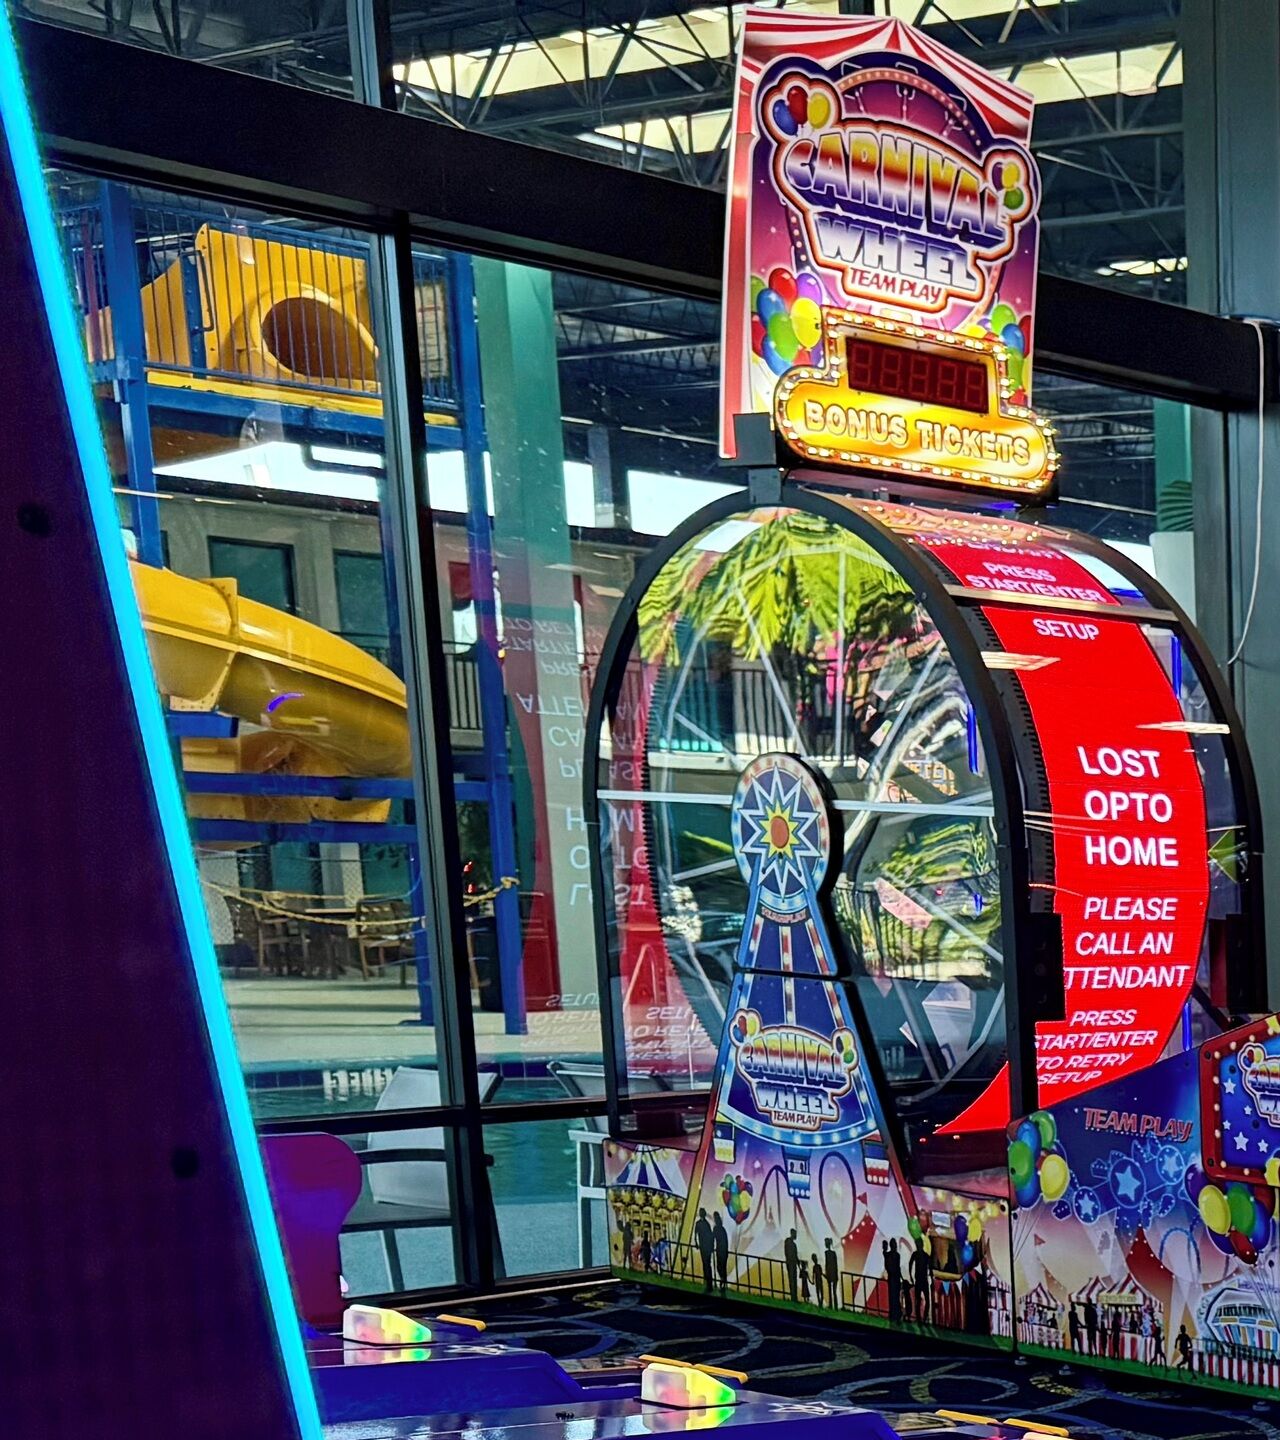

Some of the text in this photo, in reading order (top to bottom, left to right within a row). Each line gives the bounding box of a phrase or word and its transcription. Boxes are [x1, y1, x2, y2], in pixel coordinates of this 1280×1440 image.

[785, 131, 1007, 242] CARNIVAL
[814, 217, 978, 291] WHEEL
[848, 267, 943, 304] TEAM PLAY
[804, 399, 1031, 467] BONUS TICKETS
[982, 562, 1056, 582] PRESS
[965, 575, 1107, 603] START/ENTER
[1032, 618, 1099, 640] SETUP
[1078, 746, 1160, 778] LOST
[1084, 790, 1173, 823] OPTO
[1086, 836, 1179, 867] HOME
[1084, 897, 1178, 921] PLEASE
[1076, 932, 1173, 955] CALL AN
[1063, 965, 1190, 989] TTENDANT
[1070, 1009, 1137, 1026] PRESS
[739, 1032, 848, 1084] CARNIVAL
[1037, 1052, 1134, 1070] TO RETRY
[1038, 1070, 1102, 1085] SETUP
[756, 1081, 836, 1116] WHEEL
[773, 1111, 818, 1126] TEAM PLAY
[1083, 1107, 1193, 1140] TEAM PLAY
